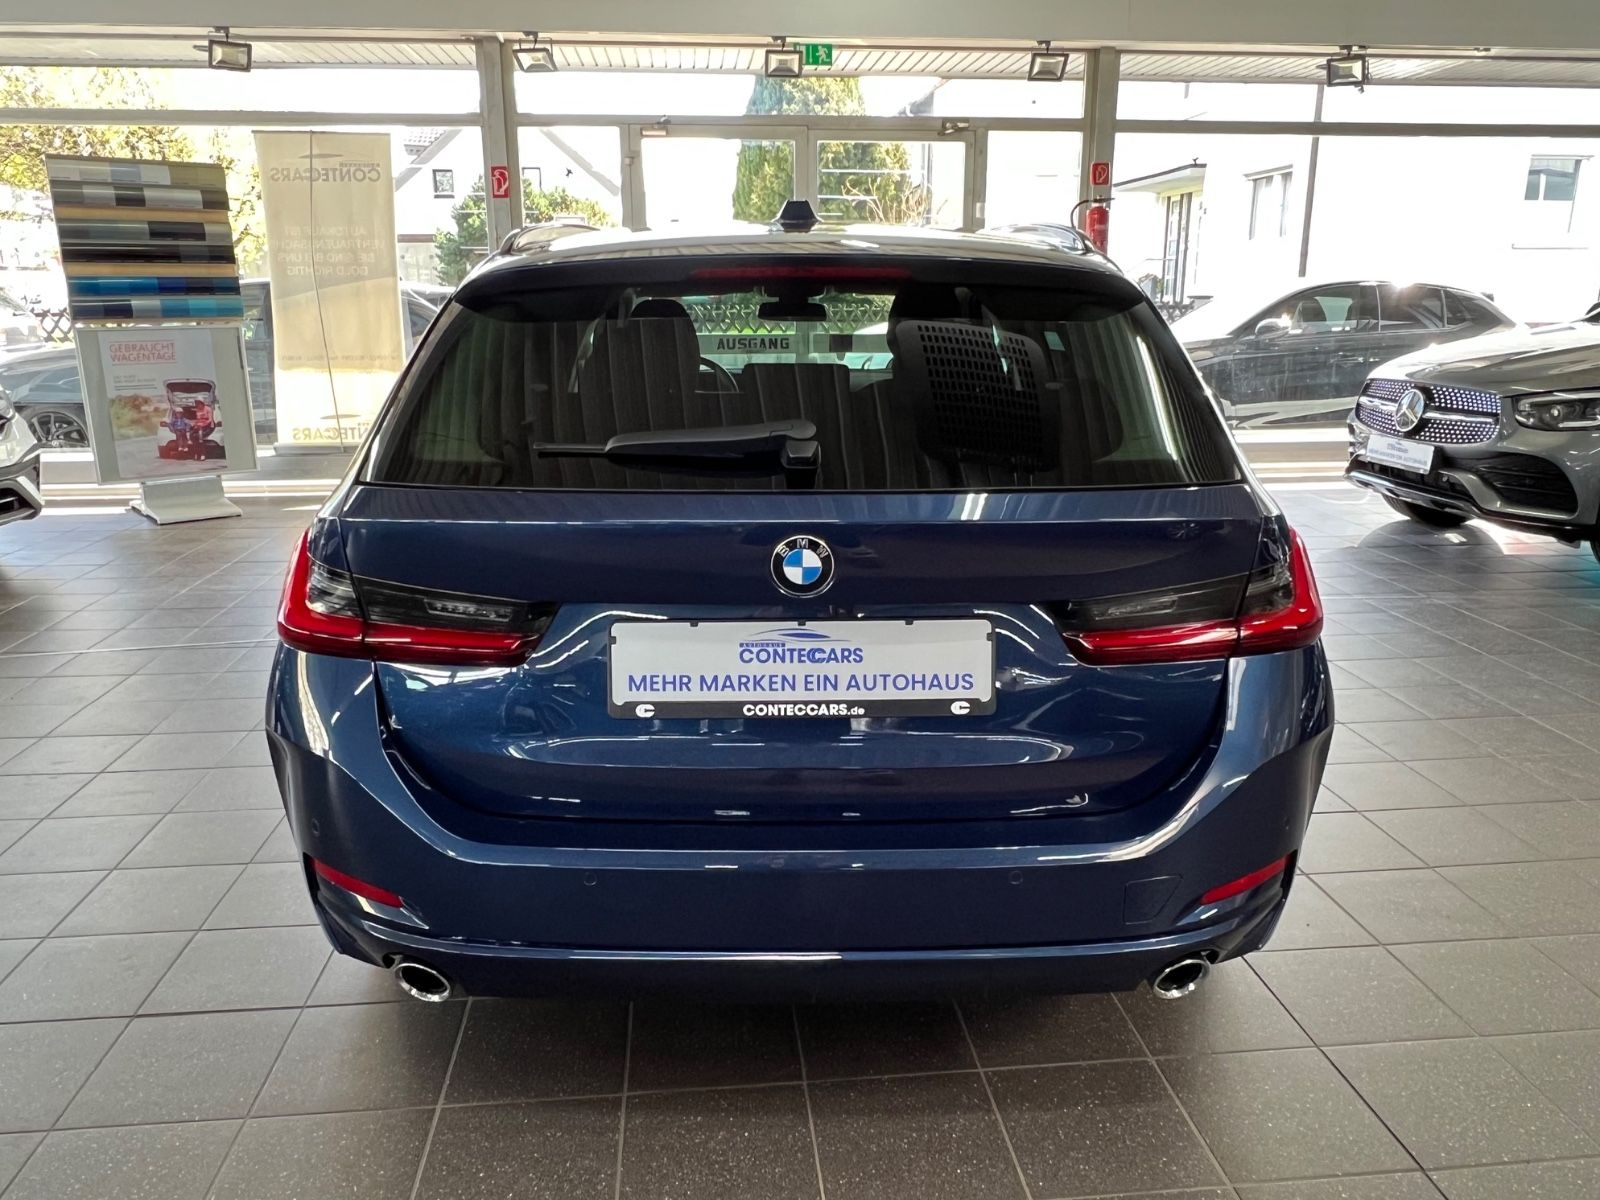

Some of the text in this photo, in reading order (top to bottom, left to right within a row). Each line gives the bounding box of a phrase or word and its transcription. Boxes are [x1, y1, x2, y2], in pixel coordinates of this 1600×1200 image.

[109, 343, 175, 353] GEBRAUCHT
[717, 338, 790, 350] AUSGANG
[111, 352, 176, 362] WAGENTAGE
[777, 539, 829, 559] BMW
[628, 673, 974, 692] MEHR MARKEN EIN AUTOHAUS
[743, 704, 865, 716] CONTECCARS.de
